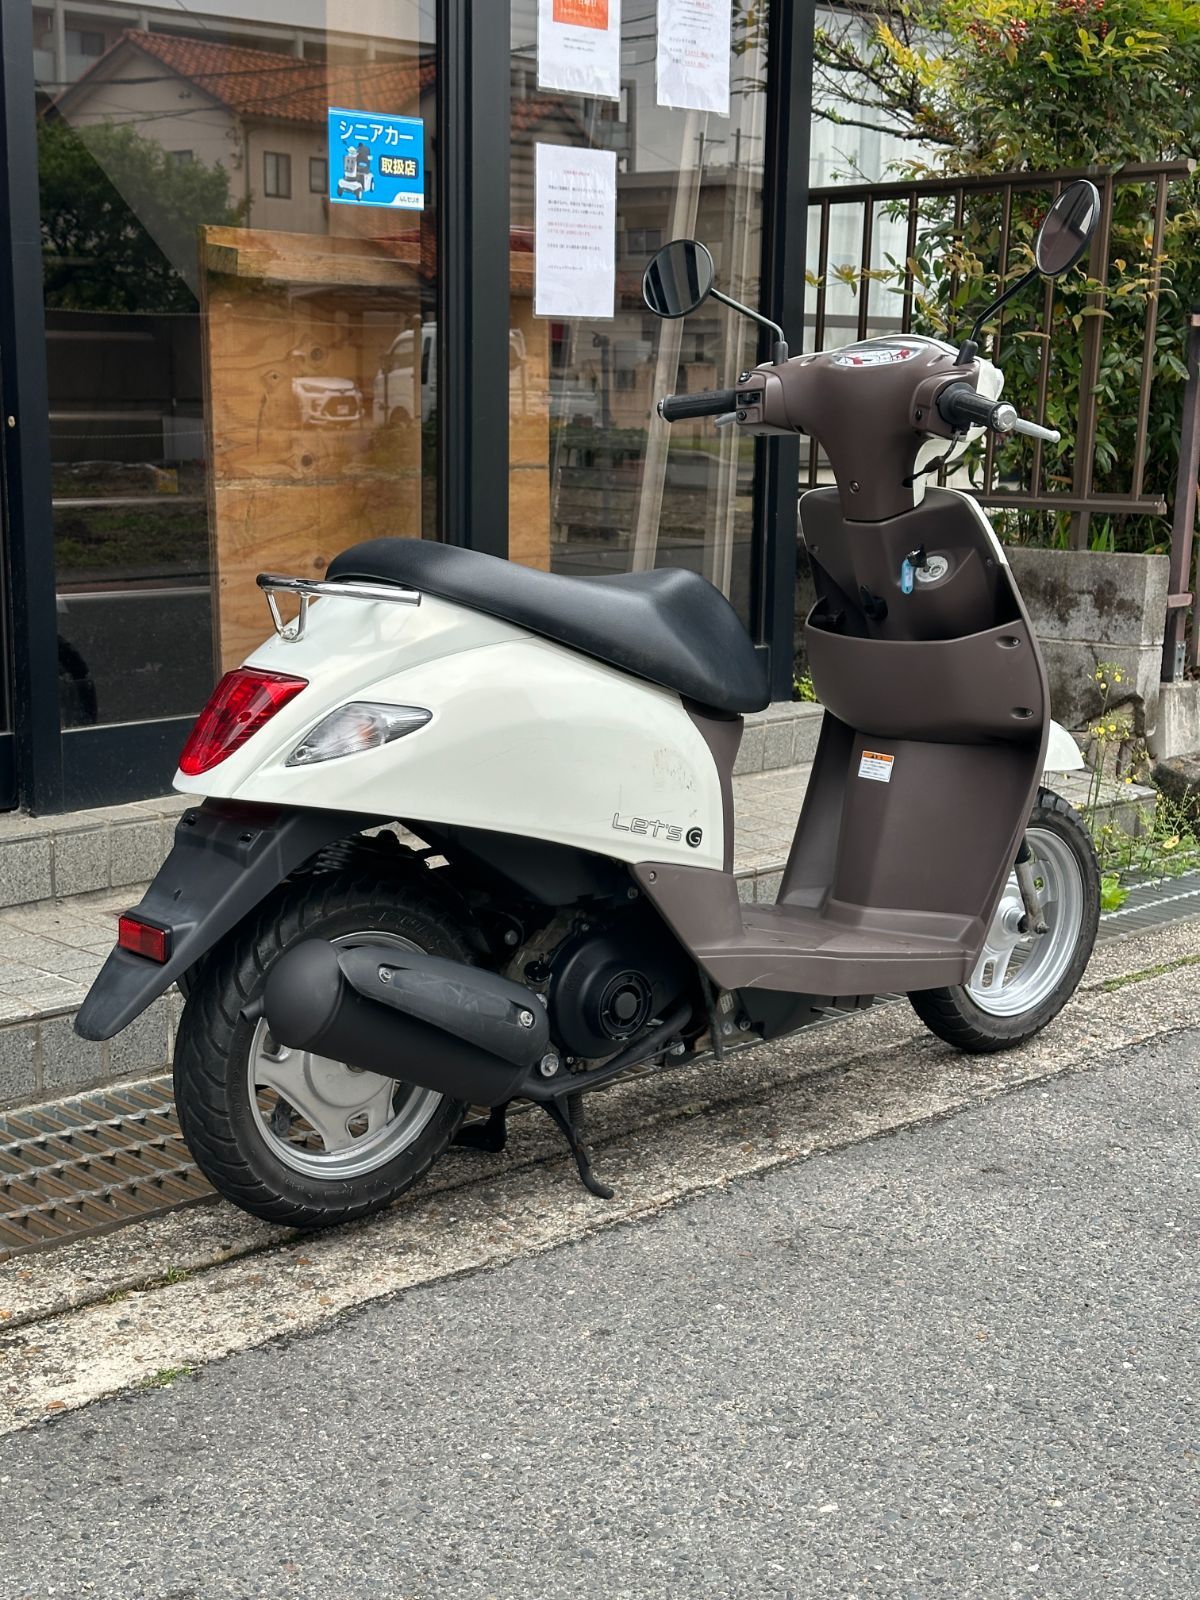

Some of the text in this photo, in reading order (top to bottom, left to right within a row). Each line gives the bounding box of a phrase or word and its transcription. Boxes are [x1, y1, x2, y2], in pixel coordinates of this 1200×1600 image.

[340, 121, 413, 145] シニアカー
[381, 157, 416, 176] 取扱店
[612, 812, 703, 848] Let's G
